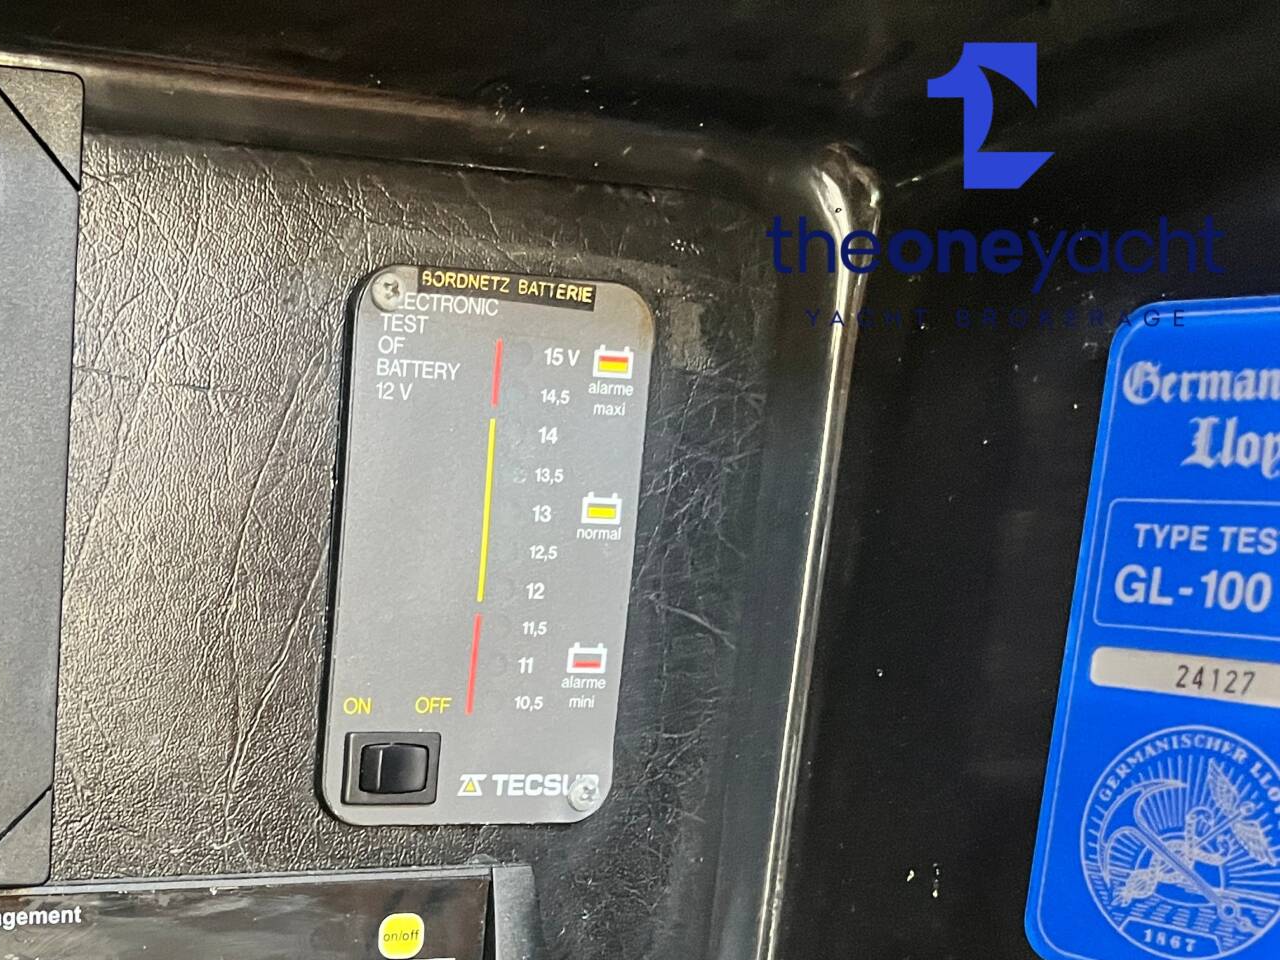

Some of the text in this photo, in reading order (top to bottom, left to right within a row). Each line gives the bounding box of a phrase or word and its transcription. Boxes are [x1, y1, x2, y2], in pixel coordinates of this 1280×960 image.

[422, 270, 593, 303] BORDNETZ BATTERIE
[380, 313, 429, 335] TEST
[378, 336, 405, 355] OF
[544, 348, 580, 367] 15 V
[376, 359, 460, 381] BATTERY
[376, 382, 413, 401] 12 V
[541, 389, 570, 405] 14,5
[588, 382, 634, 396] alarme
[593, 402, 626, 416] maxi
[538, 427, 558, 445] 14
[535, 468, 564, 484] 13,5
[533, 505, 552, 523] 13
[576, 527, 622, 541] normal
[1133, 523, 1209, 551] TYPE
[529, 545, 558, 560] 12,5
[526, 583, 545, 600] 12
[1114, 564, 1272, 613] GL-100
[522, 621, 547, 636] 11,5
[518, 658, 534, 675] 11
[561, 677, 606, 690] alarme
[1175, 664, 1256, 695] 24127
[343, 697, 452, 715] ON OFF
[514, 696, 543, 711] 10,5
[569, 696, 594, 709] mini
[1099, 733, 1249, 803] GERMANISCHER
[383, 929, 419, 943] on/off
[1143, 928, 1197, 952] 1867
